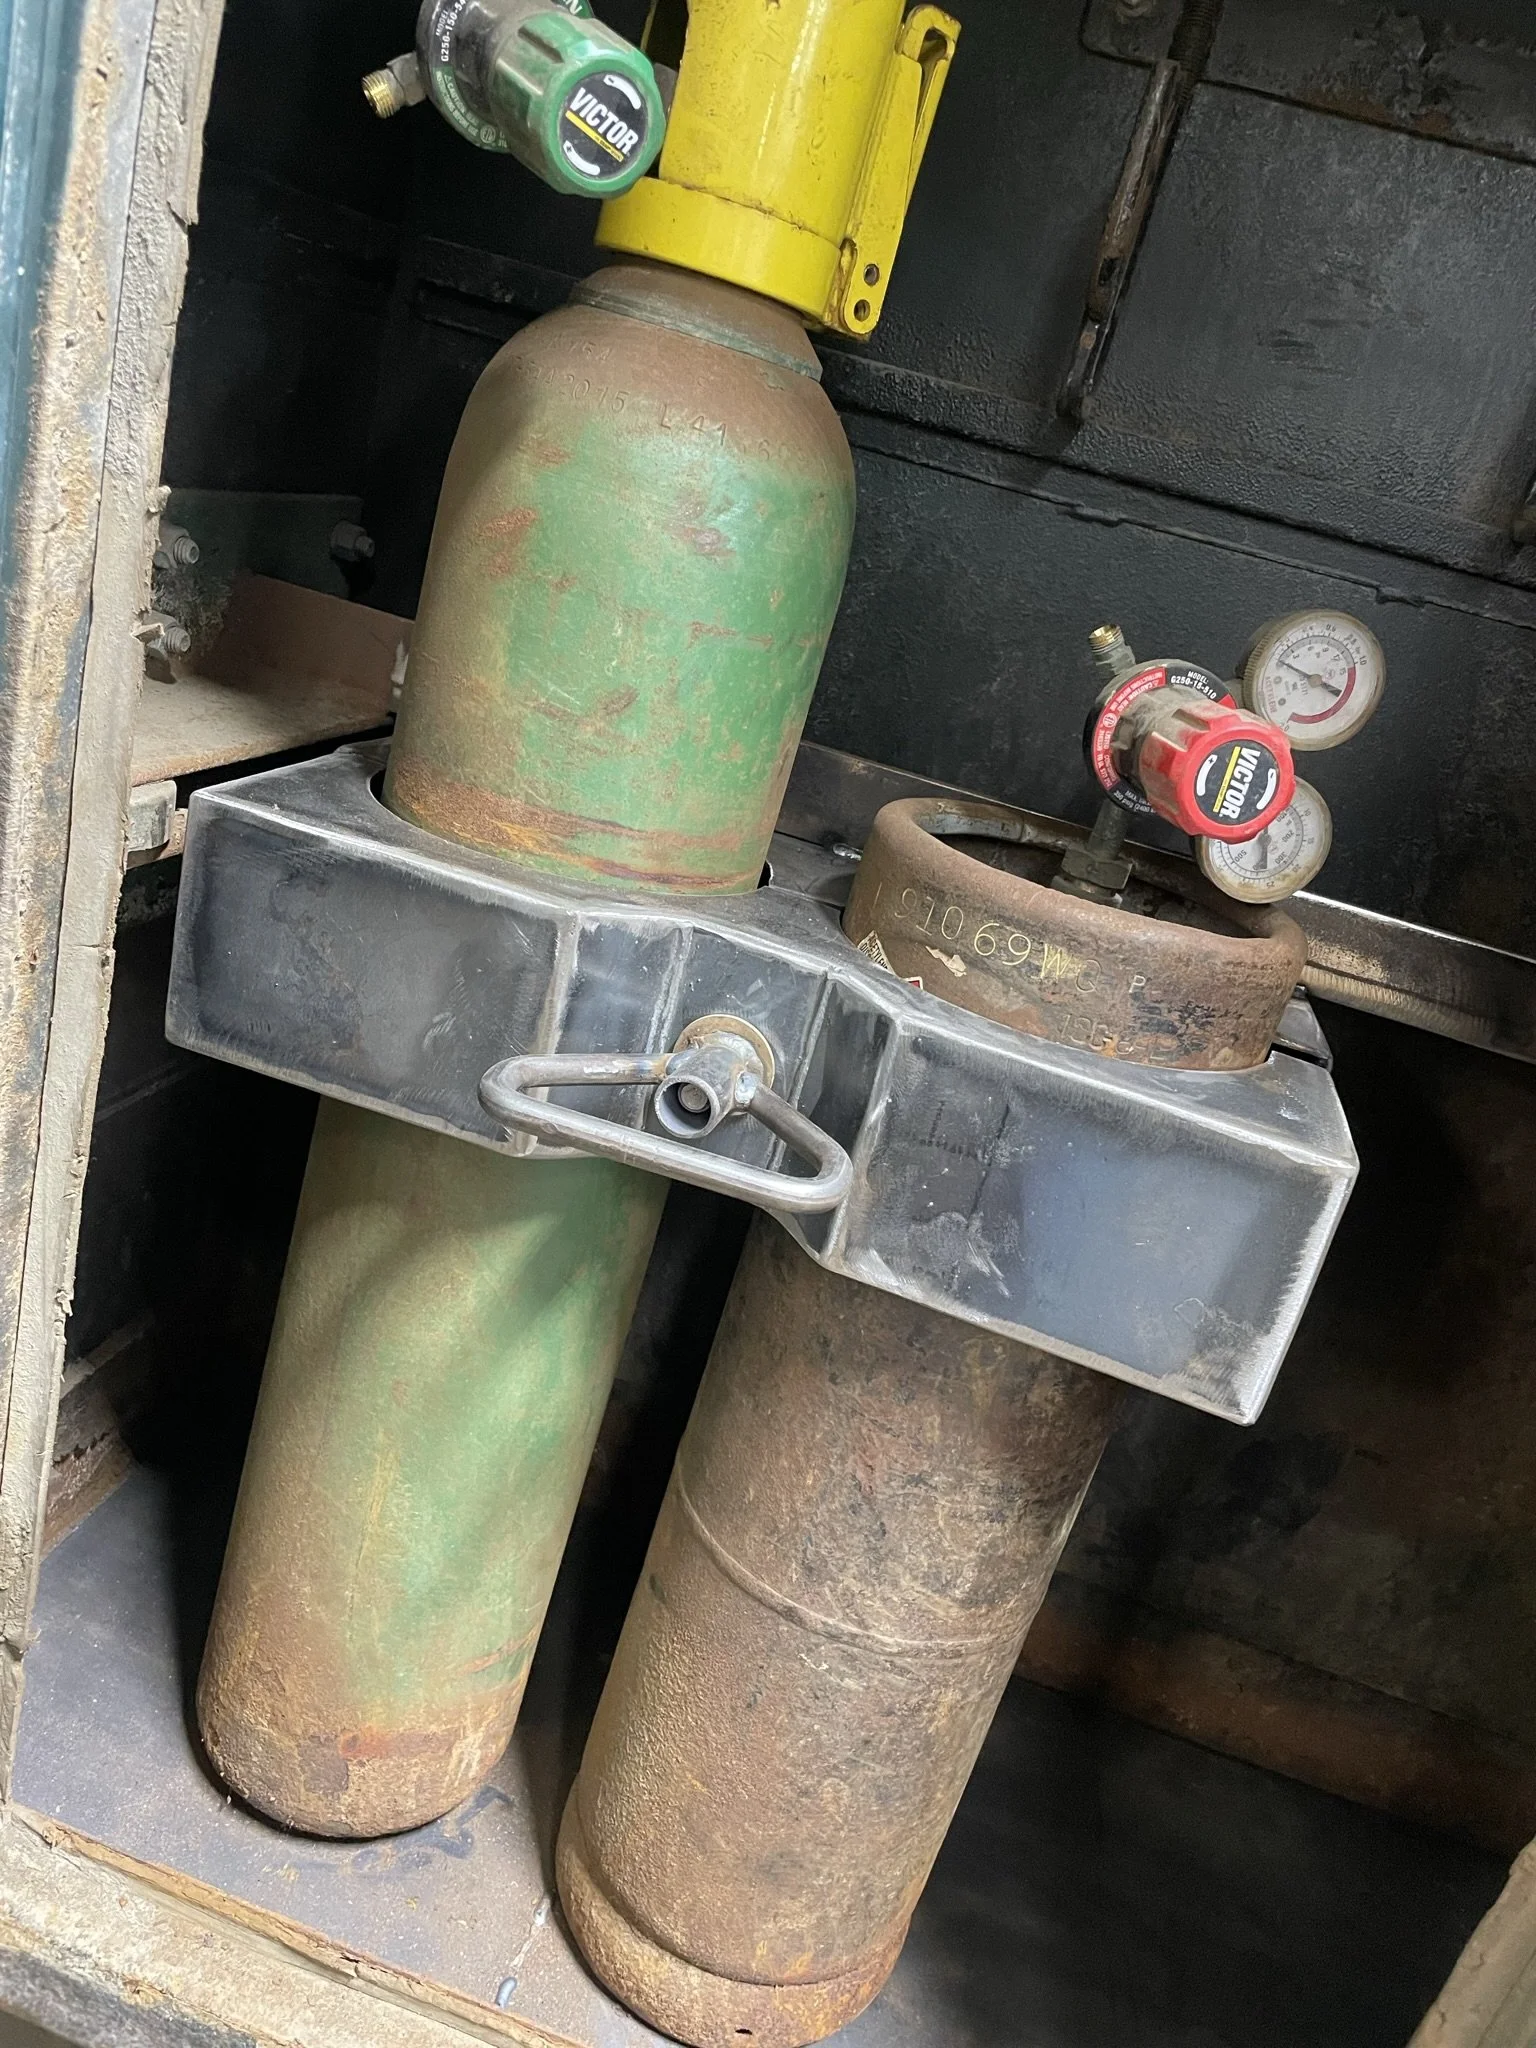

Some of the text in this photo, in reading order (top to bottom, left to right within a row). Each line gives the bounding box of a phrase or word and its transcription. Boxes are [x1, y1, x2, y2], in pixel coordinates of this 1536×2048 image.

[569, 87, 639, 155] VICTOR
[1170, 674, 1217, 700] G250-15-510
[1220, 747, 1261, 819] VICTOR
